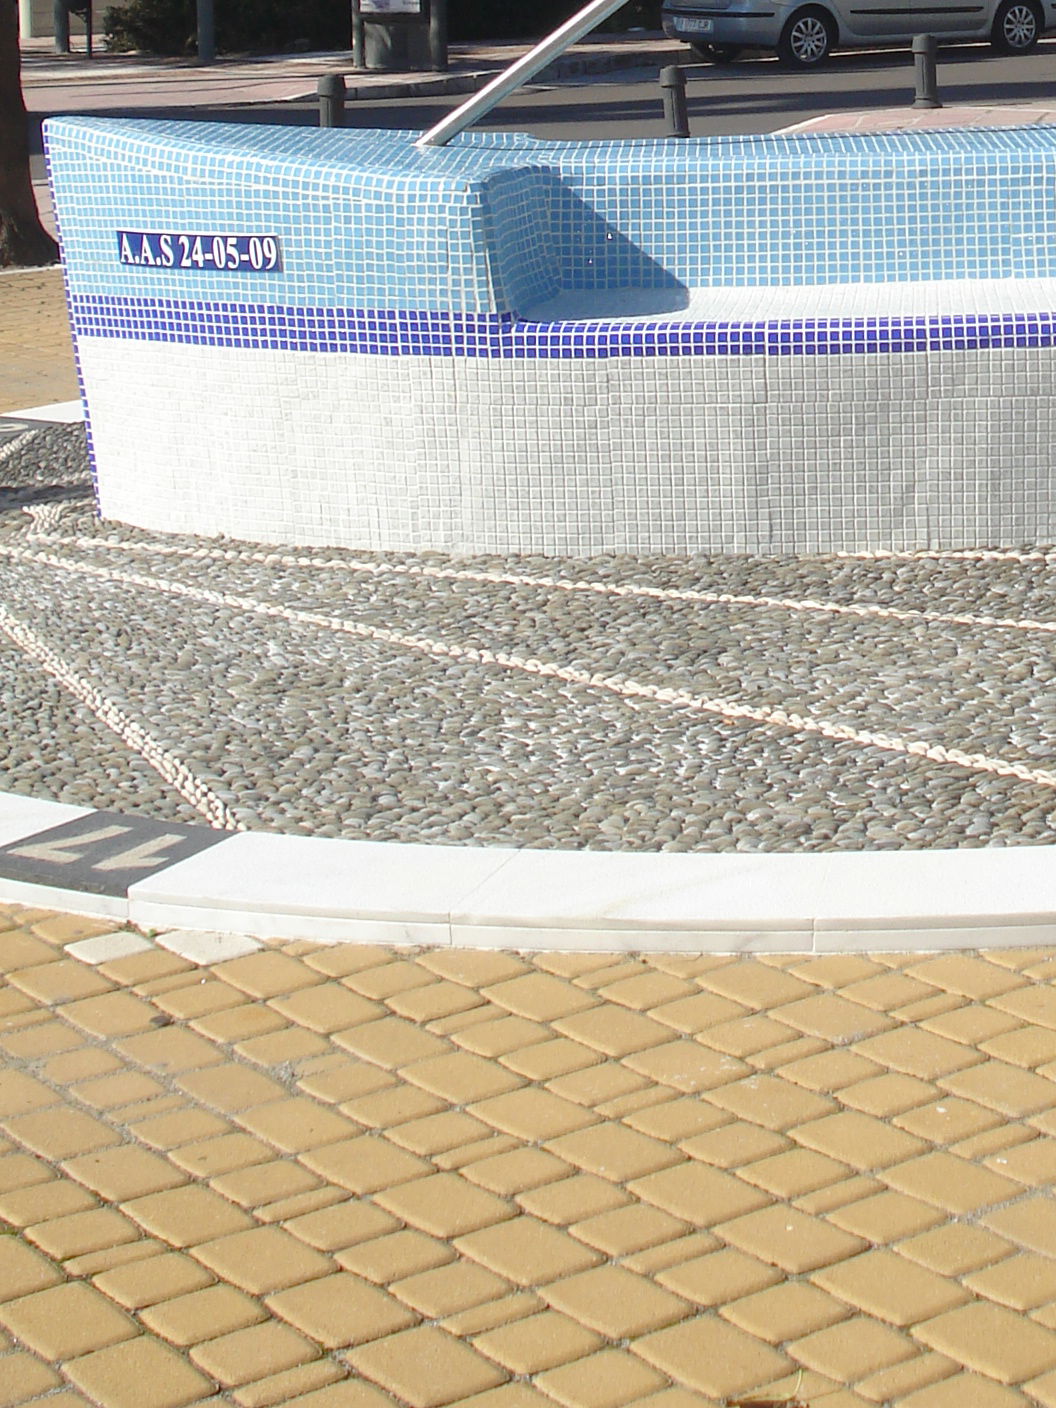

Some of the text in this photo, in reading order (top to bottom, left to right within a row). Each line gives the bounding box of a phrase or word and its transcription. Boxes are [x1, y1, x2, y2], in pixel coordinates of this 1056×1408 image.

[120, 233, 277, 270] A.A.S 24-05-09
[6, 824, 188, 872] 17
